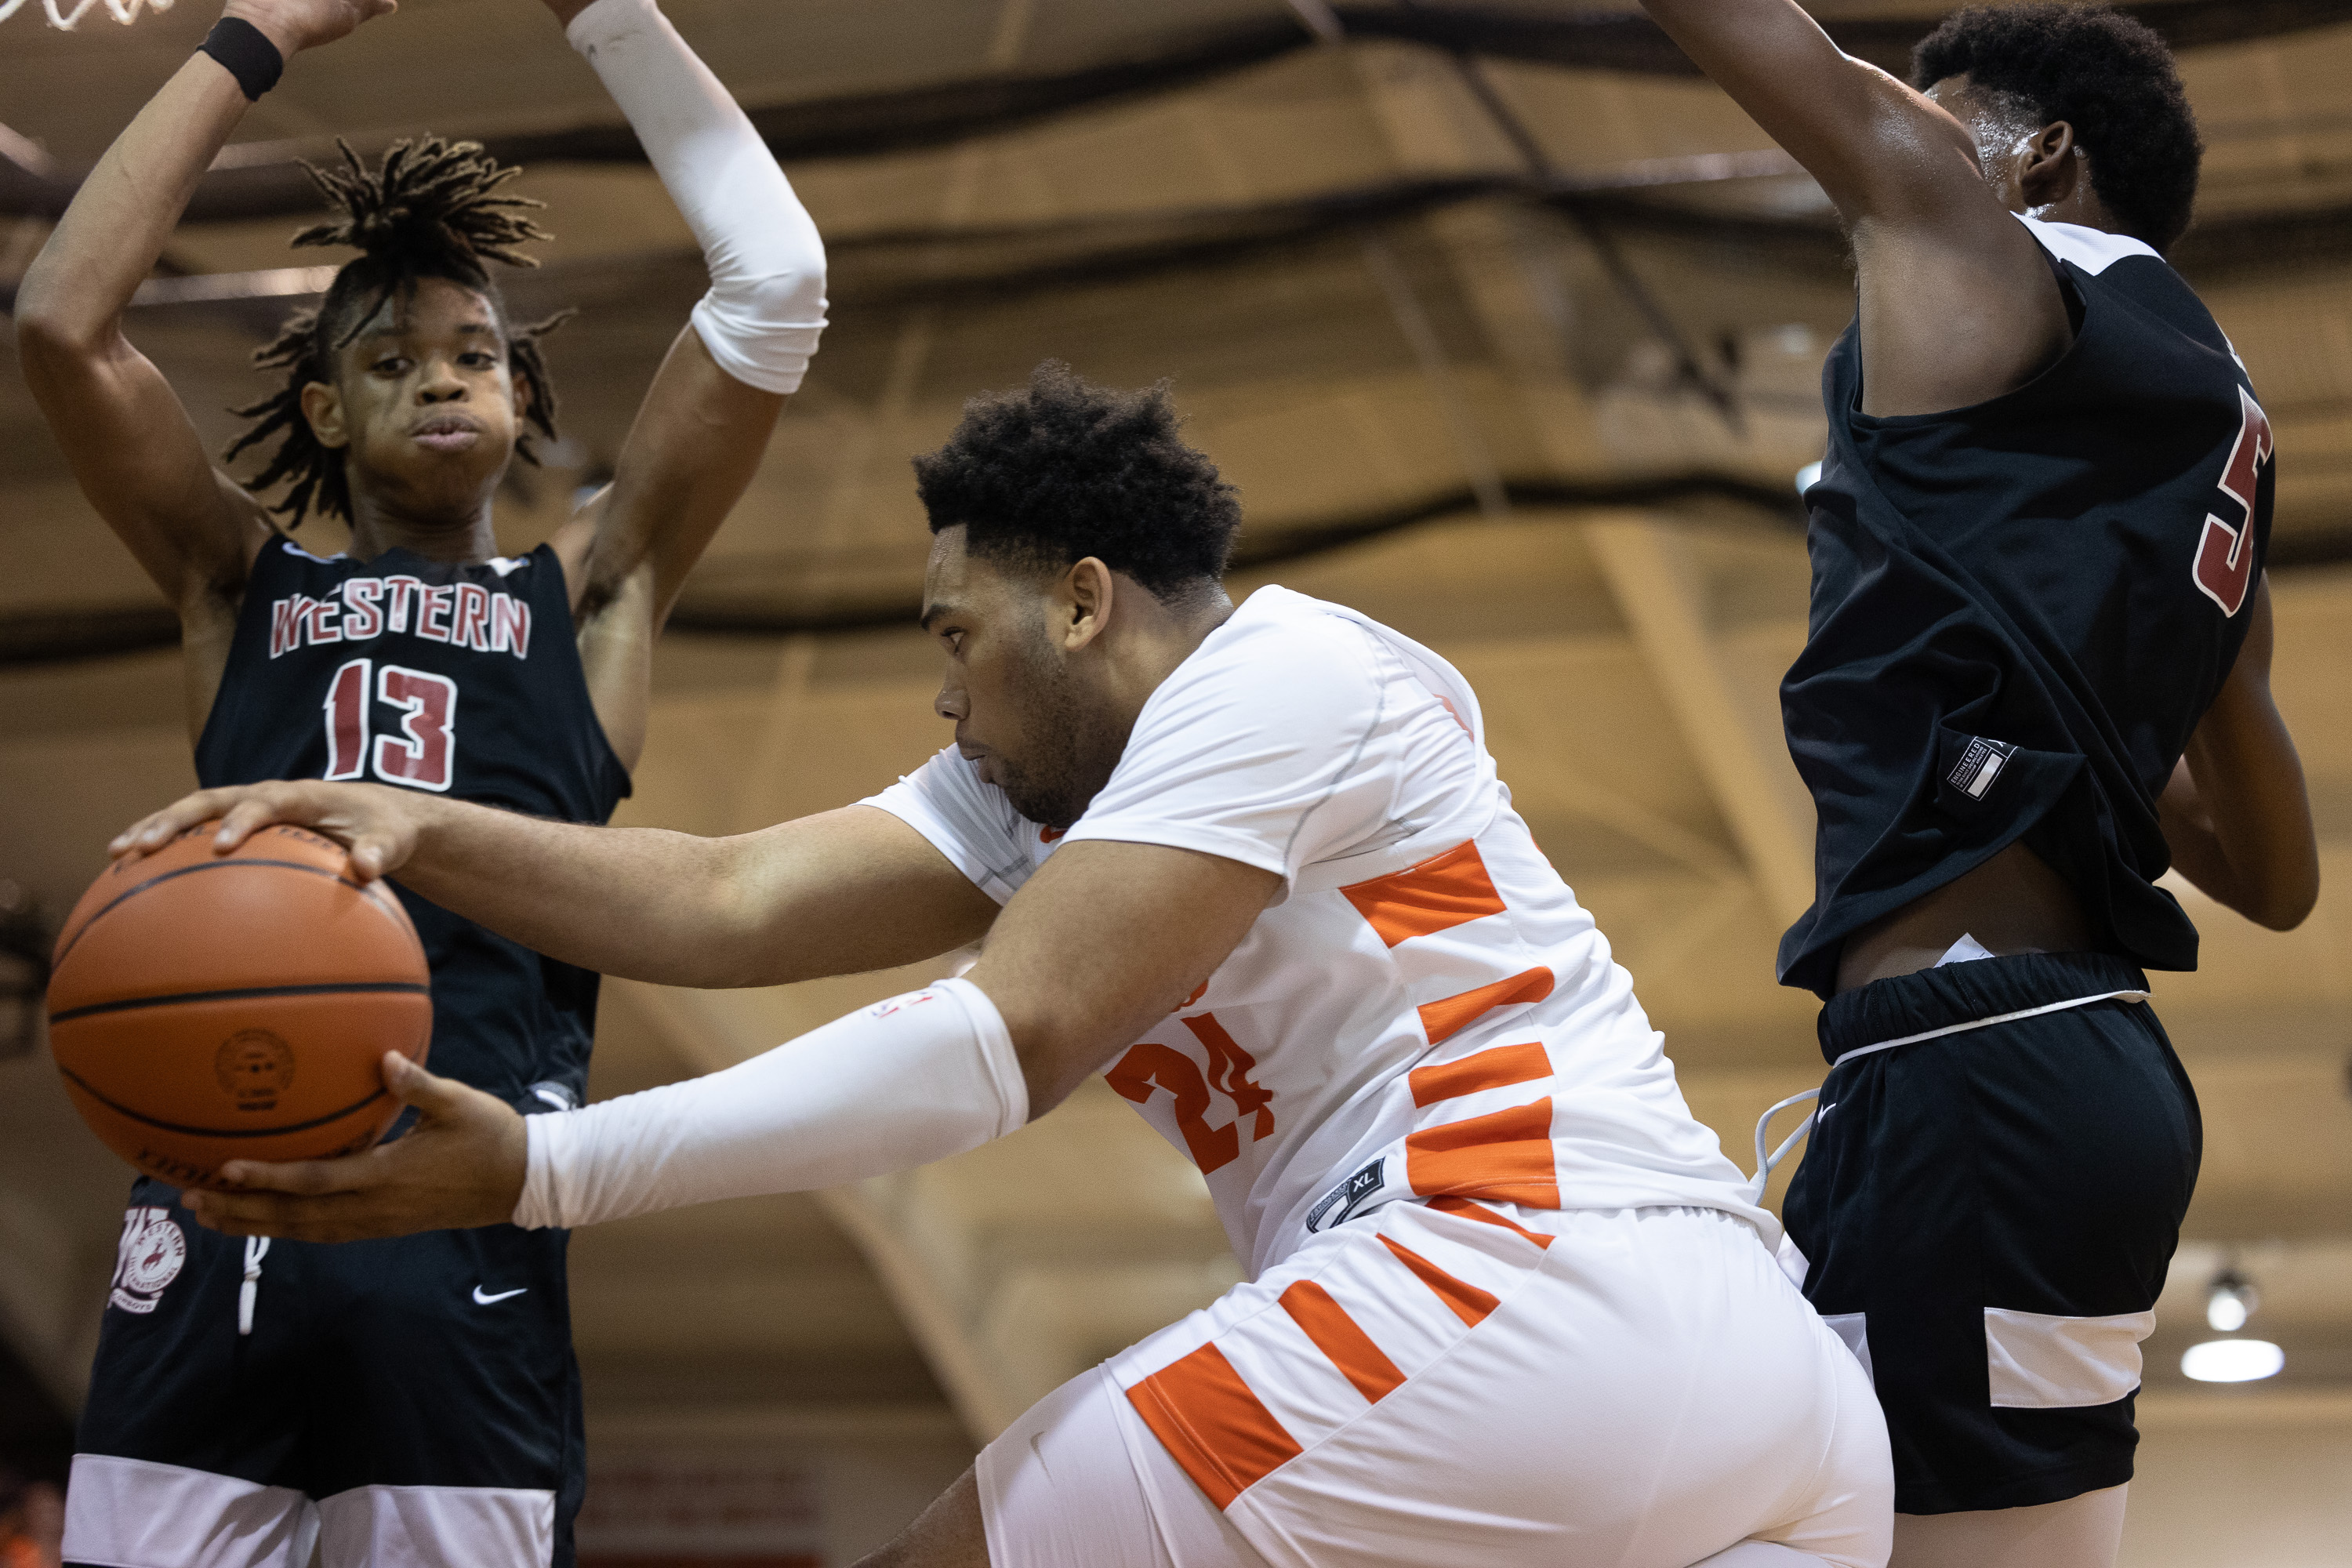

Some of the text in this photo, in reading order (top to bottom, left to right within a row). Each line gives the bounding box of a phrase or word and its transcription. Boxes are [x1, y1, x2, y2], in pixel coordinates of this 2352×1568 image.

[2192, 384, 2273, 618] 5
[269, 575, 531, 660] WESTERN
[322, 658, 458, 792] 13
[1951, 743, 1980, 783] ENGINEERED
[1104, 1011, 1275, 1176] 24
[1353, 1173, 1374, 1192] XL
[136, 1222, 183, 1257] WESTERN
